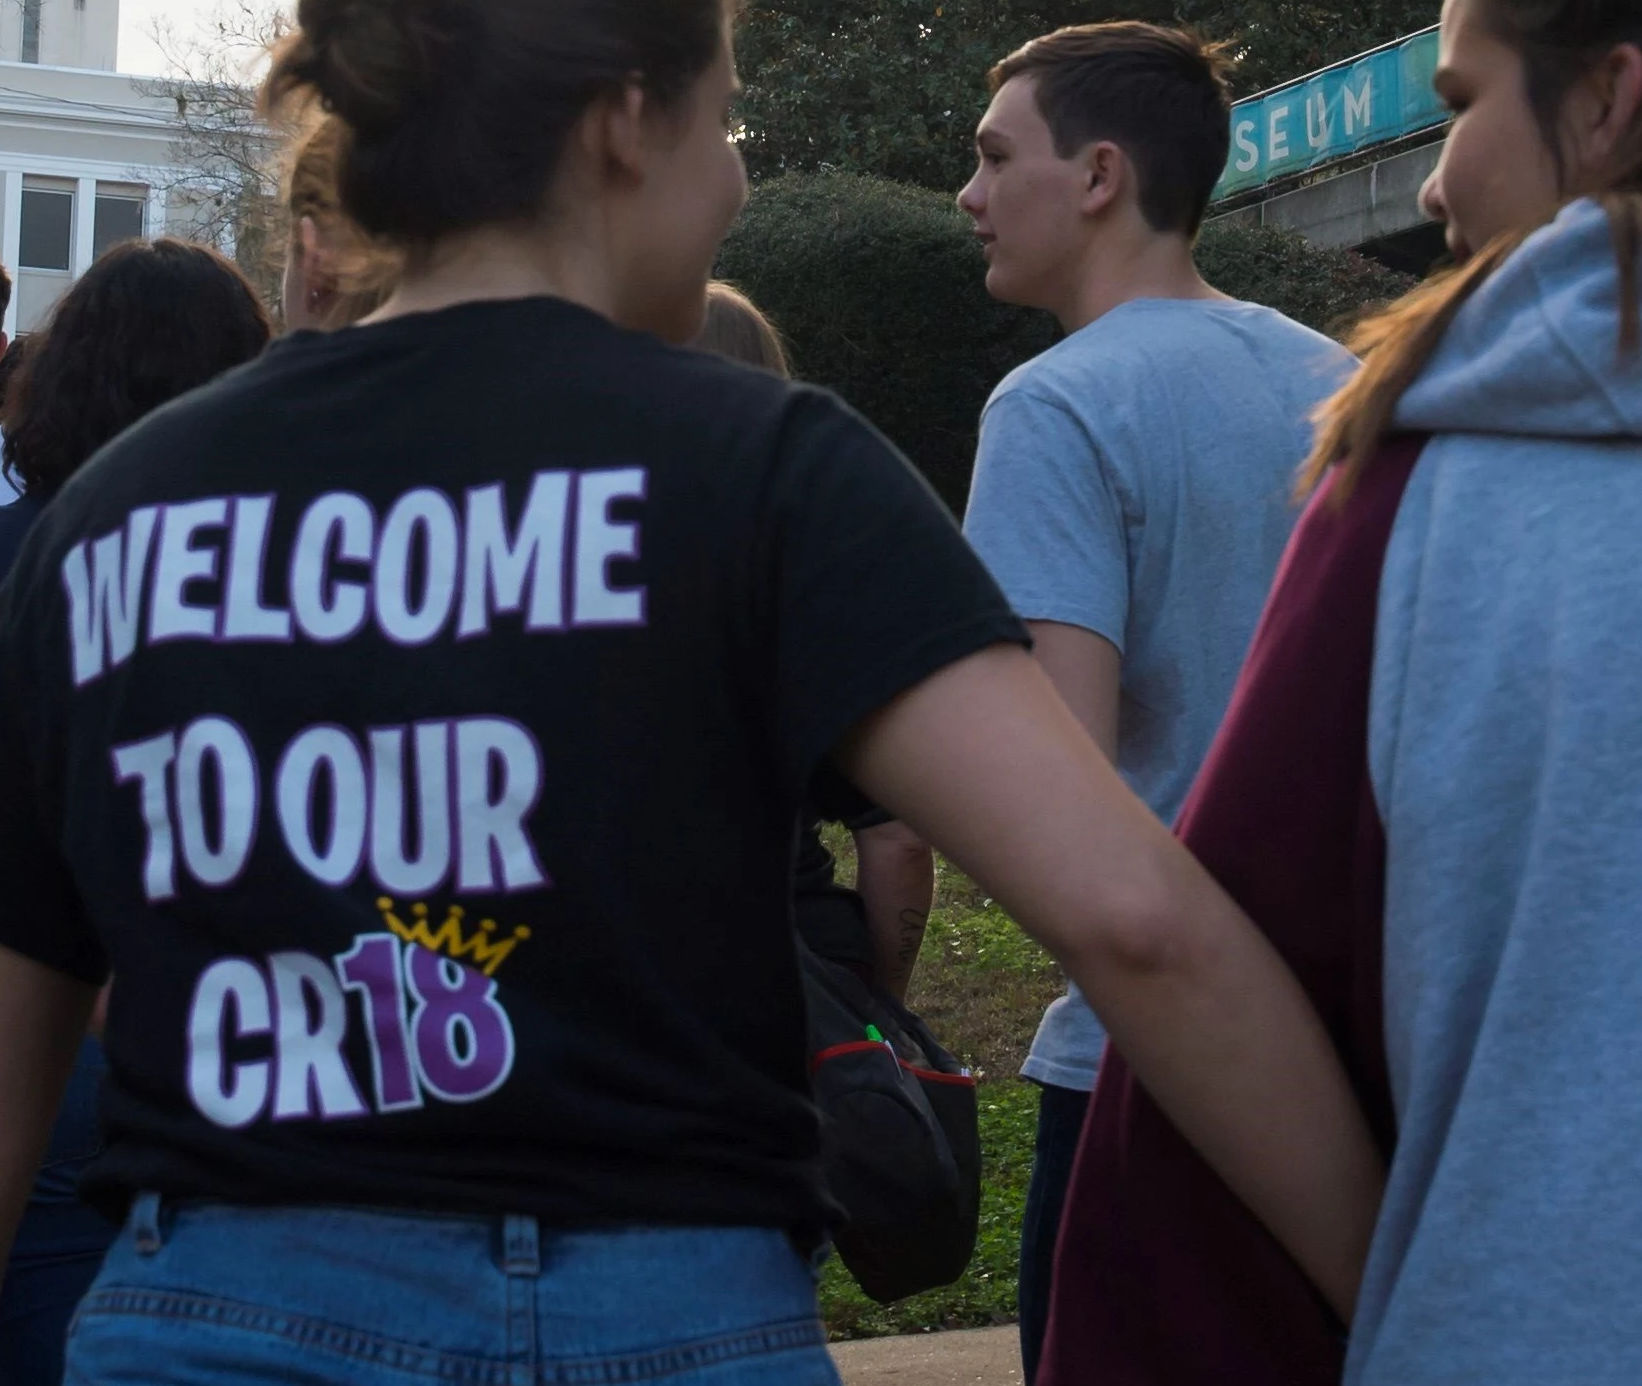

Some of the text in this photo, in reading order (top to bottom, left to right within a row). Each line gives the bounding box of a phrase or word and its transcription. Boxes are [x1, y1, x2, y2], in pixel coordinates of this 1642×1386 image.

[1219, 71, 1371, 182] SEUM
[60, 467, 648, 688] WELCOME
[113, 715, 549, 902] TO OUR
[185, 929, 516, 1129] CR18
